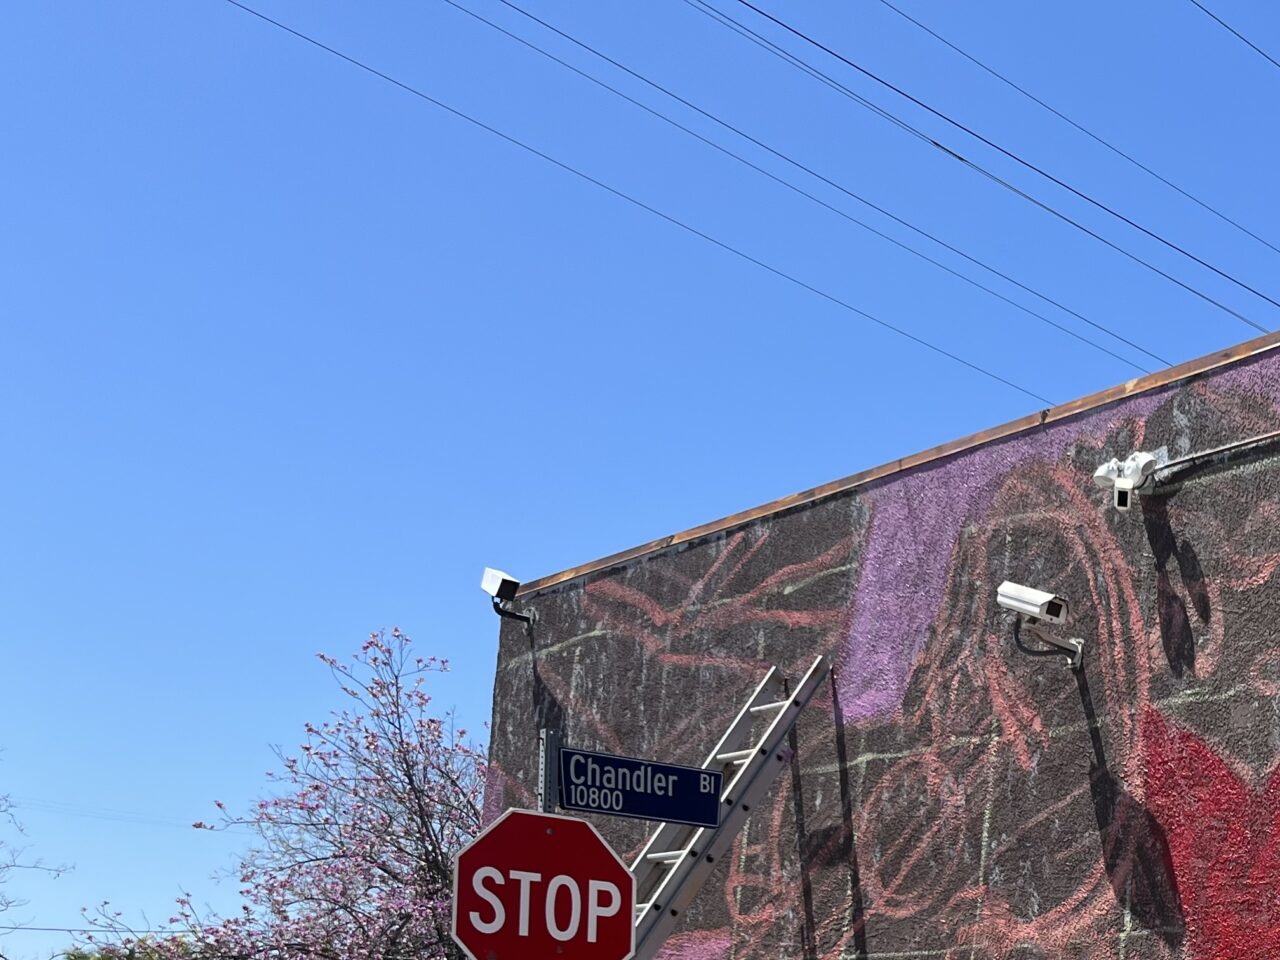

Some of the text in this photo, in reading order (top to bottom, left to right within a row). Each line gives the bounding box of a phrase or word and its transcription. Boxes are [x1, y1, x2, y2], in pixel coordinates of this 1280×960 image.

[569, 754, 678, 797] Chandler
[570, 785, 623, 811] 10800
[469, 866, 622, 943] STOP
